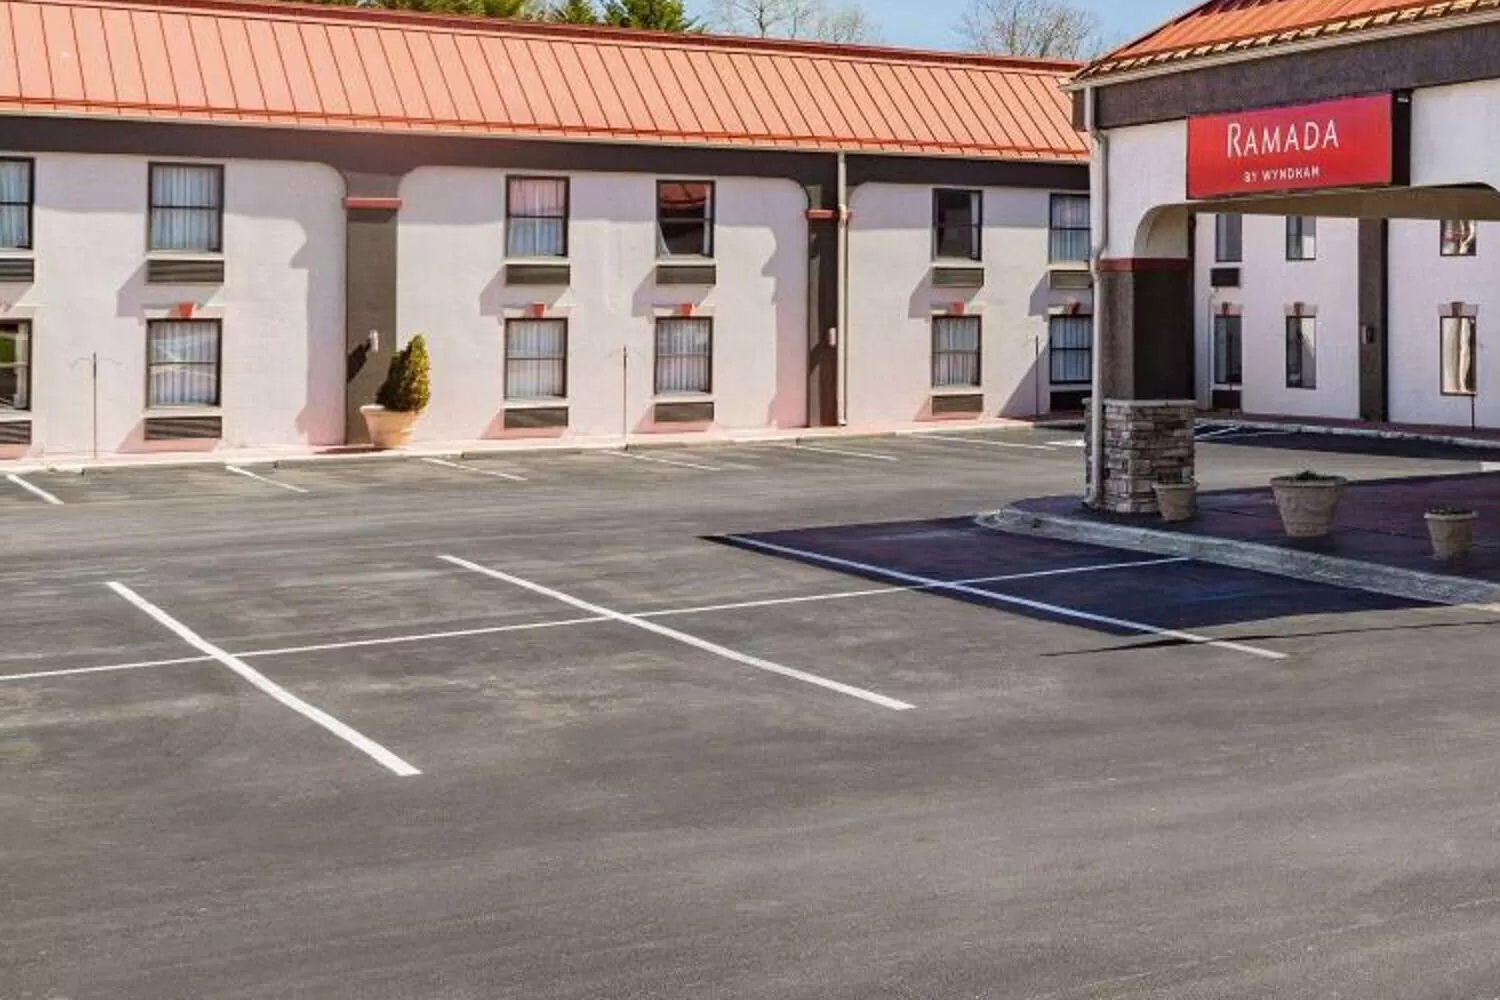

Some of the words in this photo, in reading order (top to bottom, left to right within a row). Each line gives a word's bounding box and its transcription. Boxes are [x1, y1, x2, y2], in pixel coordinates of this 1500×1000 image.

[1226, 119, 1340, 158] RAMADA
[1243, 171, 1258, 183] BY
[1262, 165, 1320, 180] WYNDHAM
